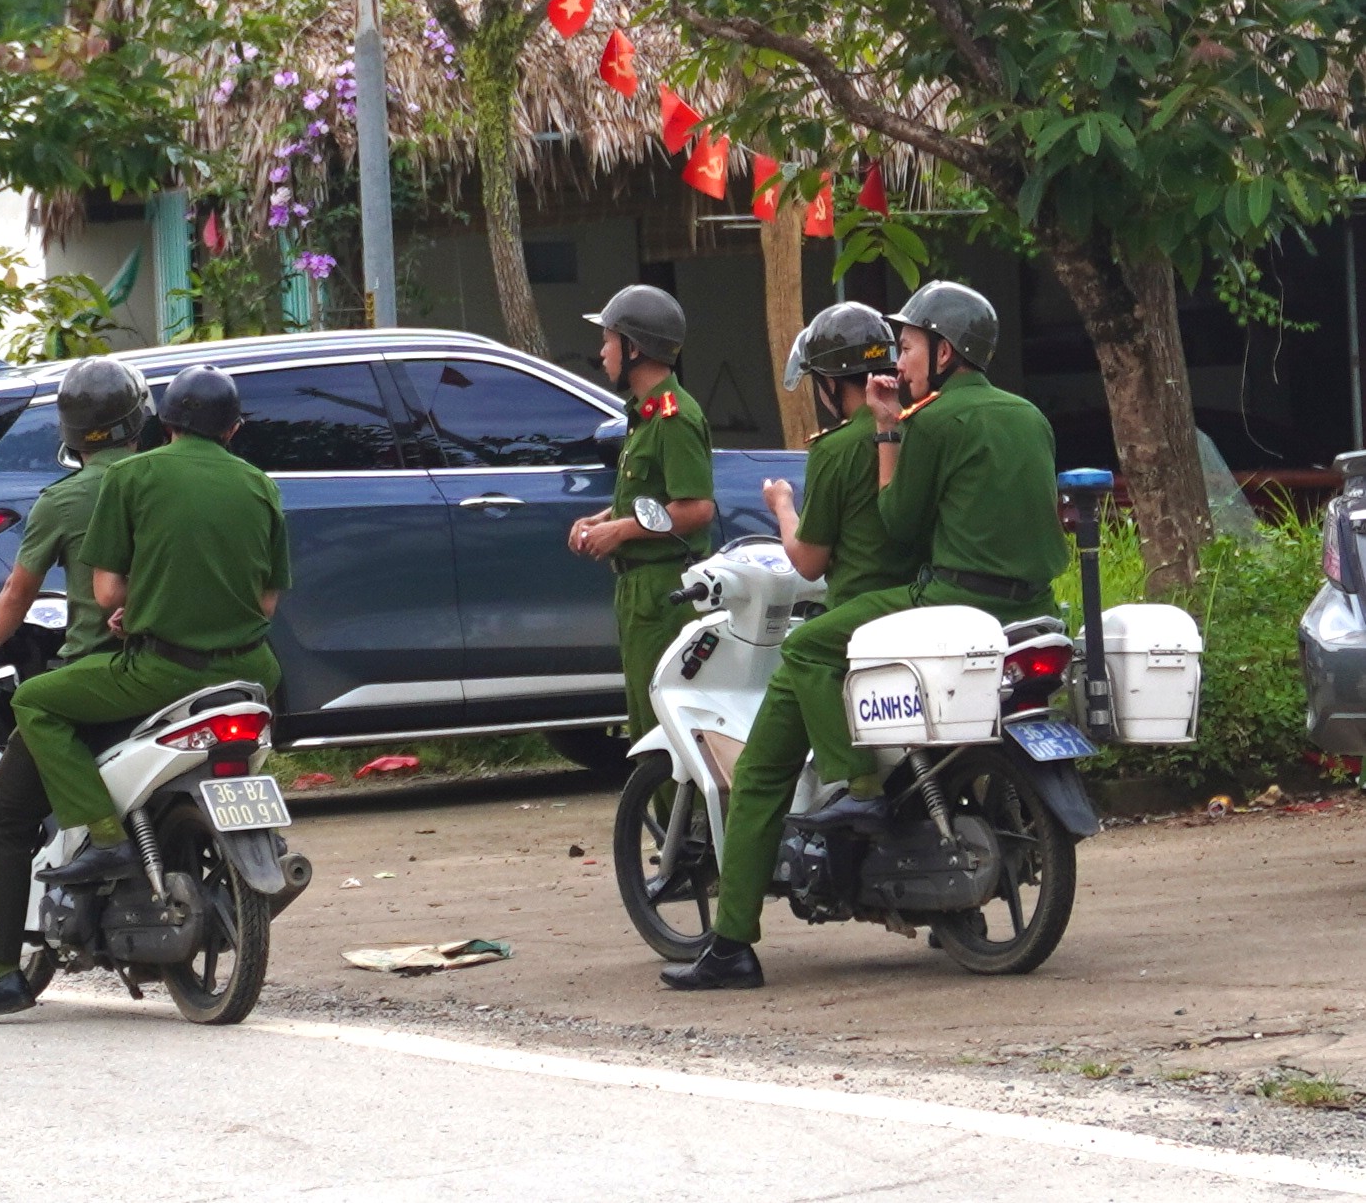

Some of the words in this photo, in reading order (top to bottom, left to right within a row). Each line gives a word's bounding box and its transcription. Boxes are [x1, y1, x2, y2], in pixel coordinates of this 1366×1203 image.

[859, 690, 903, 722] CẢNH
[1017, 722, 1072, 741] 36-B1
[1028, 737, 1094, 758] 005.71
[212, 781, 269, 803] 36-B2
[216, 802, 283, 826] 000.91
